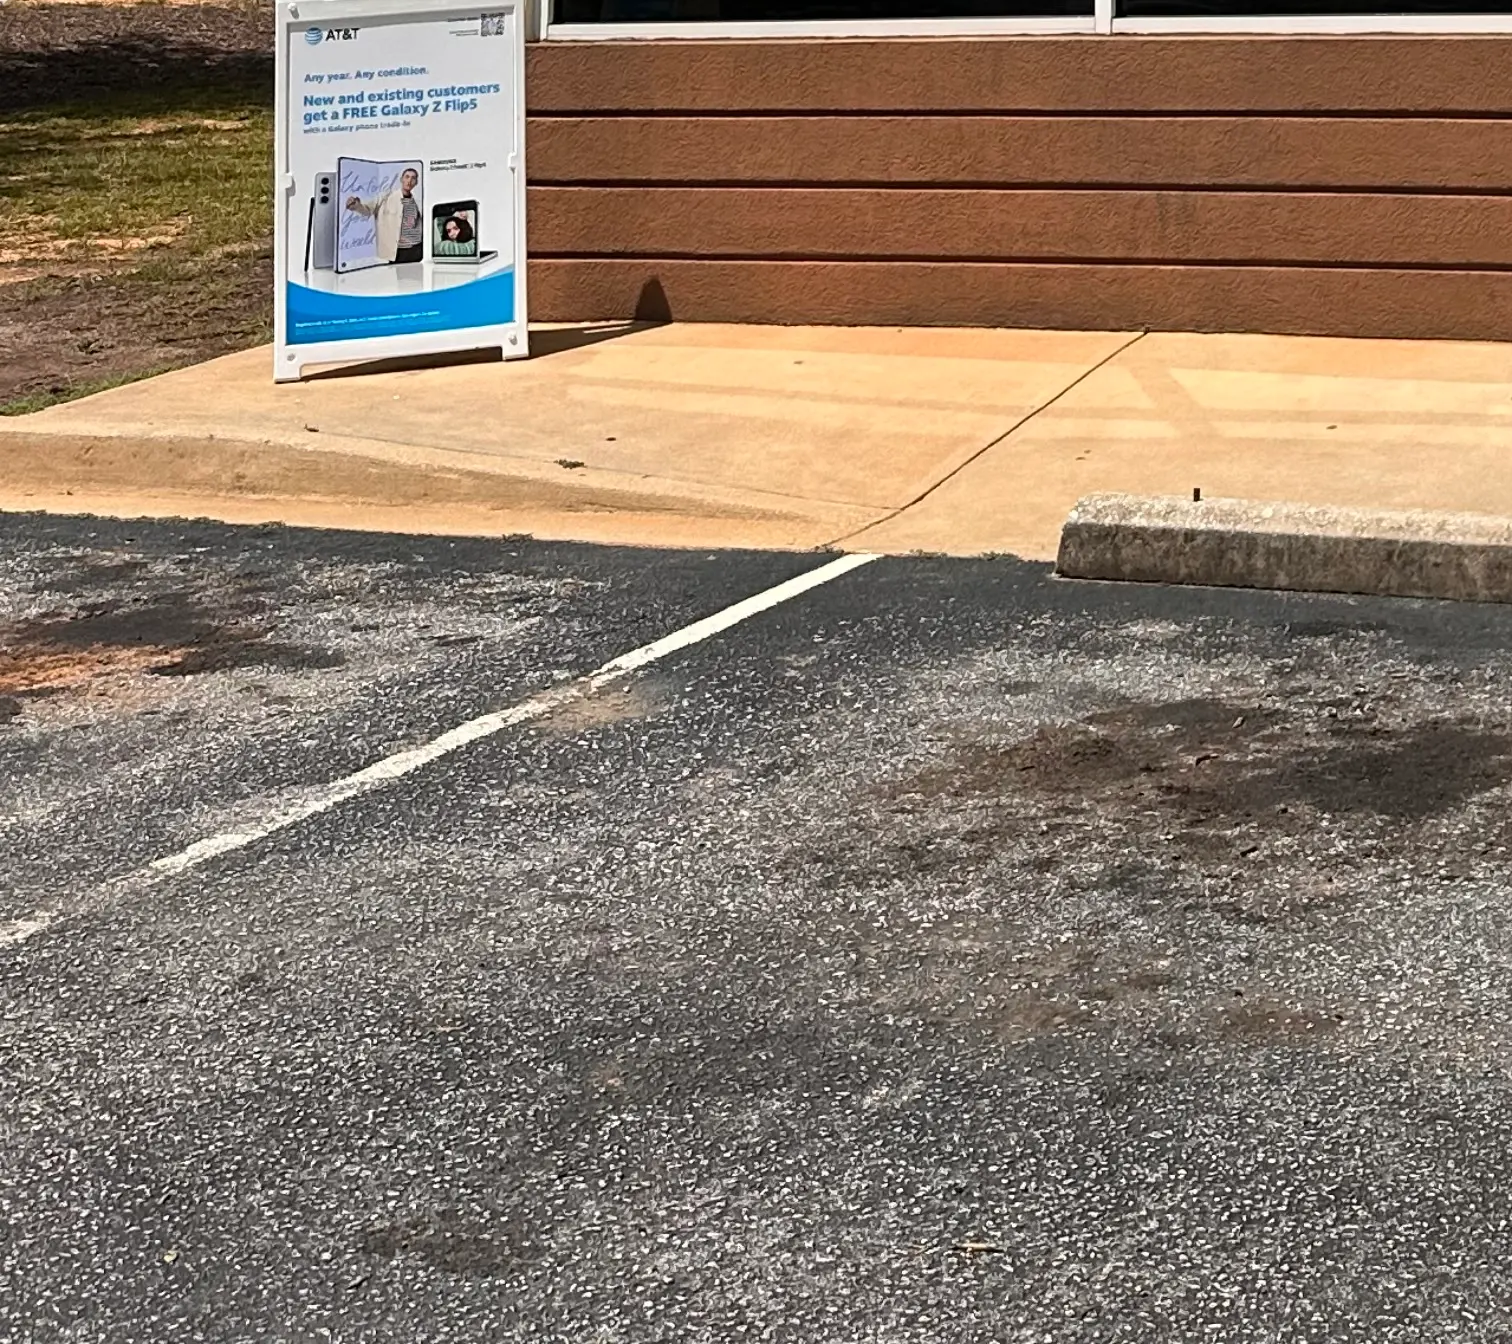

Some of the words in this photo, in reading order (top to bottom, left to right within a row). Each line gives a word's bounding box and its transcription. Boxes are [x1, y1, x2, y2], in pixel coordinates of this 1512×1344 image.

[325, 27, 360, 42] AT&T
[304, 73, 324, 84] Any
[354, 70, 375, 81] Any
[303, 94, 335, 107] New
[338, 91, 364, 105] and
[367, 87, 424, 102] existing
[427, 83, 501, 98] customers
[303, 109, 328, 125] get
[331, 110, 340, 120] a
[343, 105, 378, 120] FREE
[381, 102, 430, 118] Galaxy
[432, 100, 442, 113] Z
[445, 97, 478, 114] Flip5
